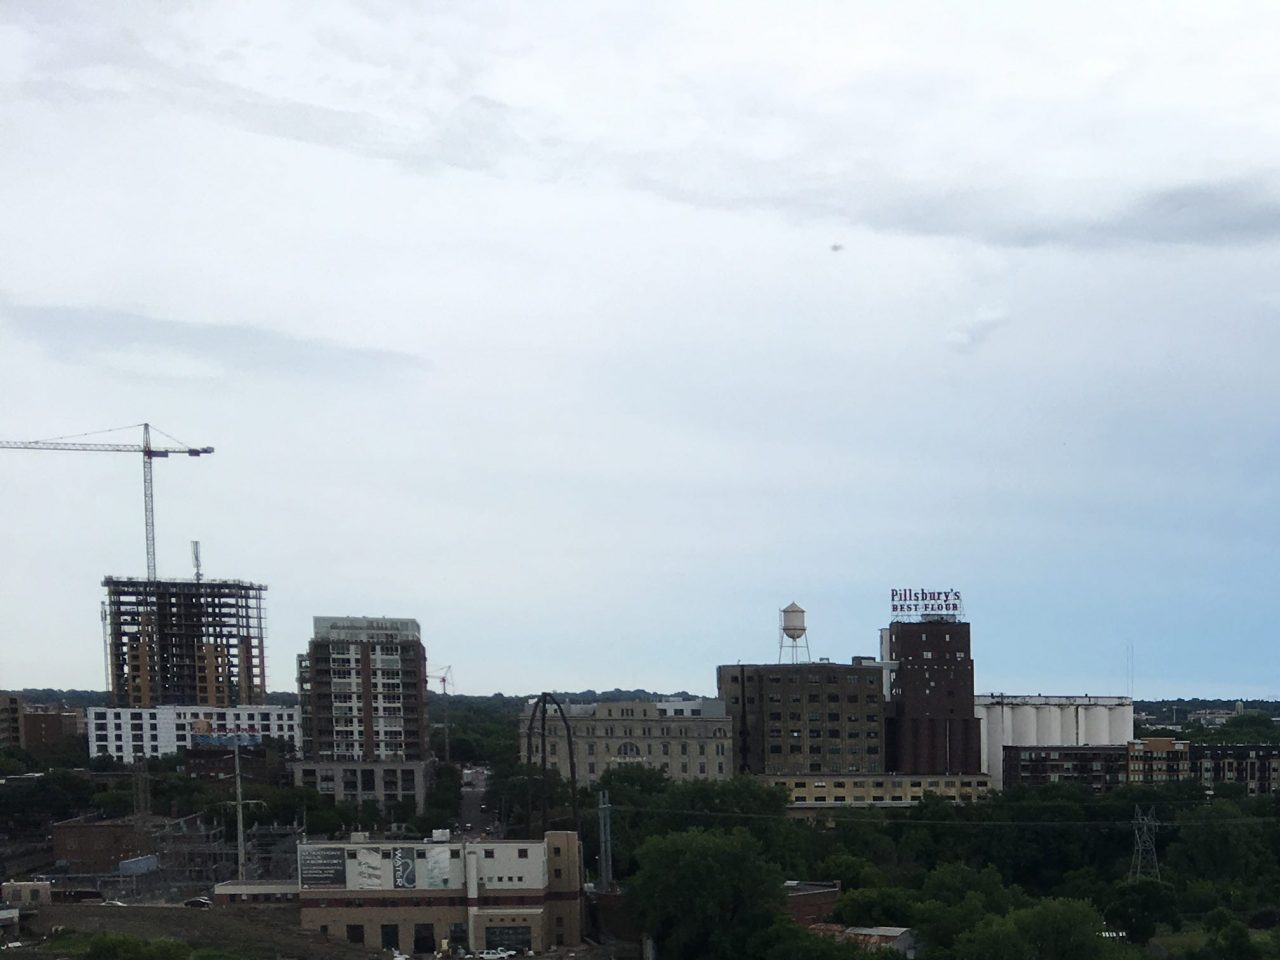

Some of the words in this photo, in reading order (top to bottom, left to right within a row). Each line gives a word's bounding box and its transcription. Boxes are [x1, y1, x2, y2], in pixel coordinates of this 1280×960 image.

[891, 588, 960, 603] Pillsbury's
[892, 603, 919, 612] BEST
[925, 603, 958, 612] FLOUR
[394, 849, 403, 887] WATER
